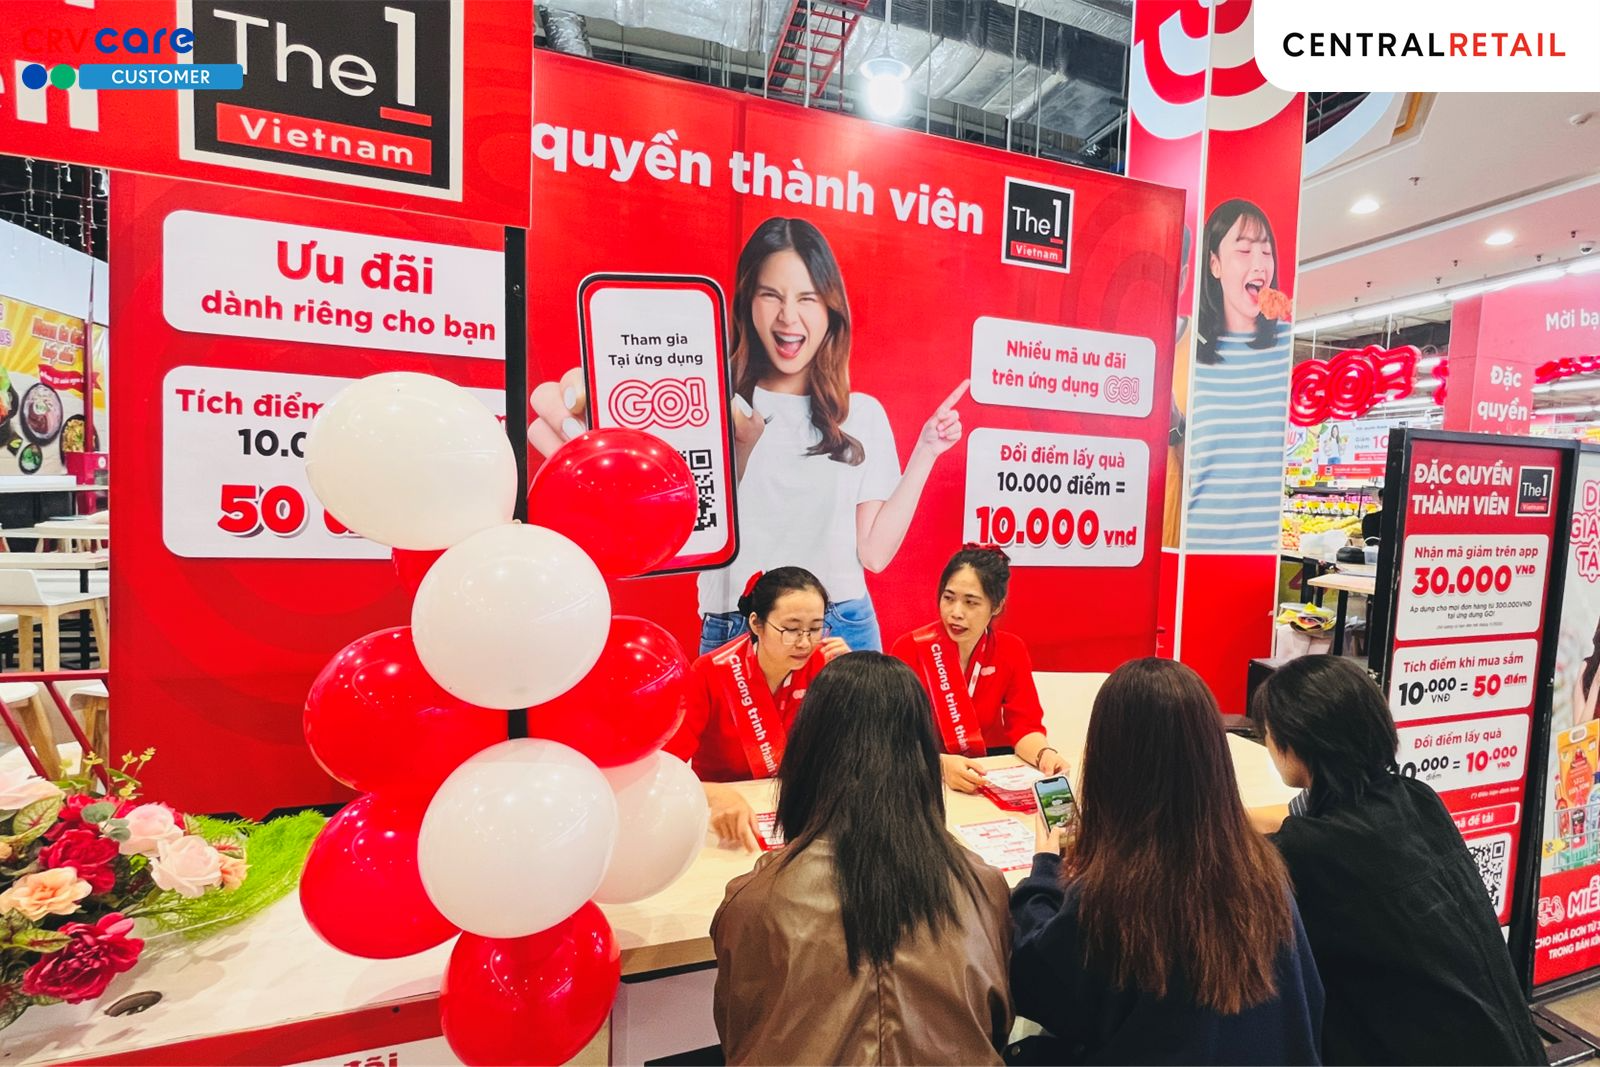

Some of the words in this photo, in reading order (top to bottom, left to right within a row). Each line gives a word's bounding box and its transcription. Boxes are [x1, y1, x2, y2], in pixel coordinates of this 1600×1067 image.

[239, 114, 414, 166] Vietnam
[533, 122, 711, 188] quyền
[729, 150, 874, 215] thành
[889, 186, 983, 235] viên
[1016, 245, 1058, 260] Vietnam
[276, 239, 344, 285] Ưu
[360, 250, 434, 295] đãi
[201, 290, 284, 321] dành
[293, 299, 373, 333] riêng
[382, 309, 436, 338] cho
[444, 316, 496, 345] bạn
[1546, 310, 1575, 331] Mời
[621, 334, 661, 346] Tham
[666, 333, 688, 346] gia
[608, 354, 630, 368] Tại
[635, 353, 662, 366] ứng
[668, 353, 703, 366] dụng
[1006, 340, 1050, 361] Nhiều
[1056, 347, 1078, 364] mã
[1082, 350, 1100, 366] ưu
[1104, 352, 1126, 369] đãi
[992, 368, 1023, 387] trên
[1028, 371, 1057, 393] ứng
[1062, 375, 1099, 397] dụng
[1103, 375, 1140, 405] GO!
[1490, 365, 1522, 391] Đặc
[176, 389, 243, 416] Tích
[608, 377, 709, 430] GO!
[1477, 397, 1528, 422] quyền
[1000, 442, 1027, 462] Đổi
[1031, 443, 1069, 465] điểm
[1073, 447, 1094, 469] lấy
[1098, 451, 1125, 470] quà
[997, 472, 1062, 493] 10.000
[1067, 472, 1110, 495] điểm
[1414, 459, 1452, 490] ĐẶC
[1455, 459, 1513, 486] QUYỀN
[217, 483, 308, 537] 50
[1412, 490, 1469, 516] THÀNH
[1473, 491, 1510, 516] VIÊN
[976, 506, 1101, 547] 10.000
[1104, 526, 1137, 547] vnd
[1414, 547, 1443, 561] Nhận
[1446, 547, 1463, 558] mã
[1466, 545, 1492, 559] giảm
[1495, 546, 1516, 557] trên
[1518, 547, 1539, 559] app
[1412, 565, 1512, 596] 30.000
[931, 643, 950, 692] Chương
[1404, 660, 1426, 673] Tích
[1429, 656, 1456, 670] điểm
[1459, 656, 1475, 668] khi
[1478, 655, 1500, 667] mua
[1503, 652, 1523, 664] sắm
[729, 654, 753, 707] Chương
[1399, 677, 1456, 706] 10.000
[1472, 674, 1501, 698] 50
[1504, 673, 1527, 685] điểm
[1431, 693, 1450, 703] VNĐ
[1414, 734, 1433, 749] Đổi
[1436, 732, 1462, 746] điểm
[1465, 730, 1480, 744] lấy
[1483, 728, 1502, 741] quà
[1466, 745, 1518, 773] 10.000
